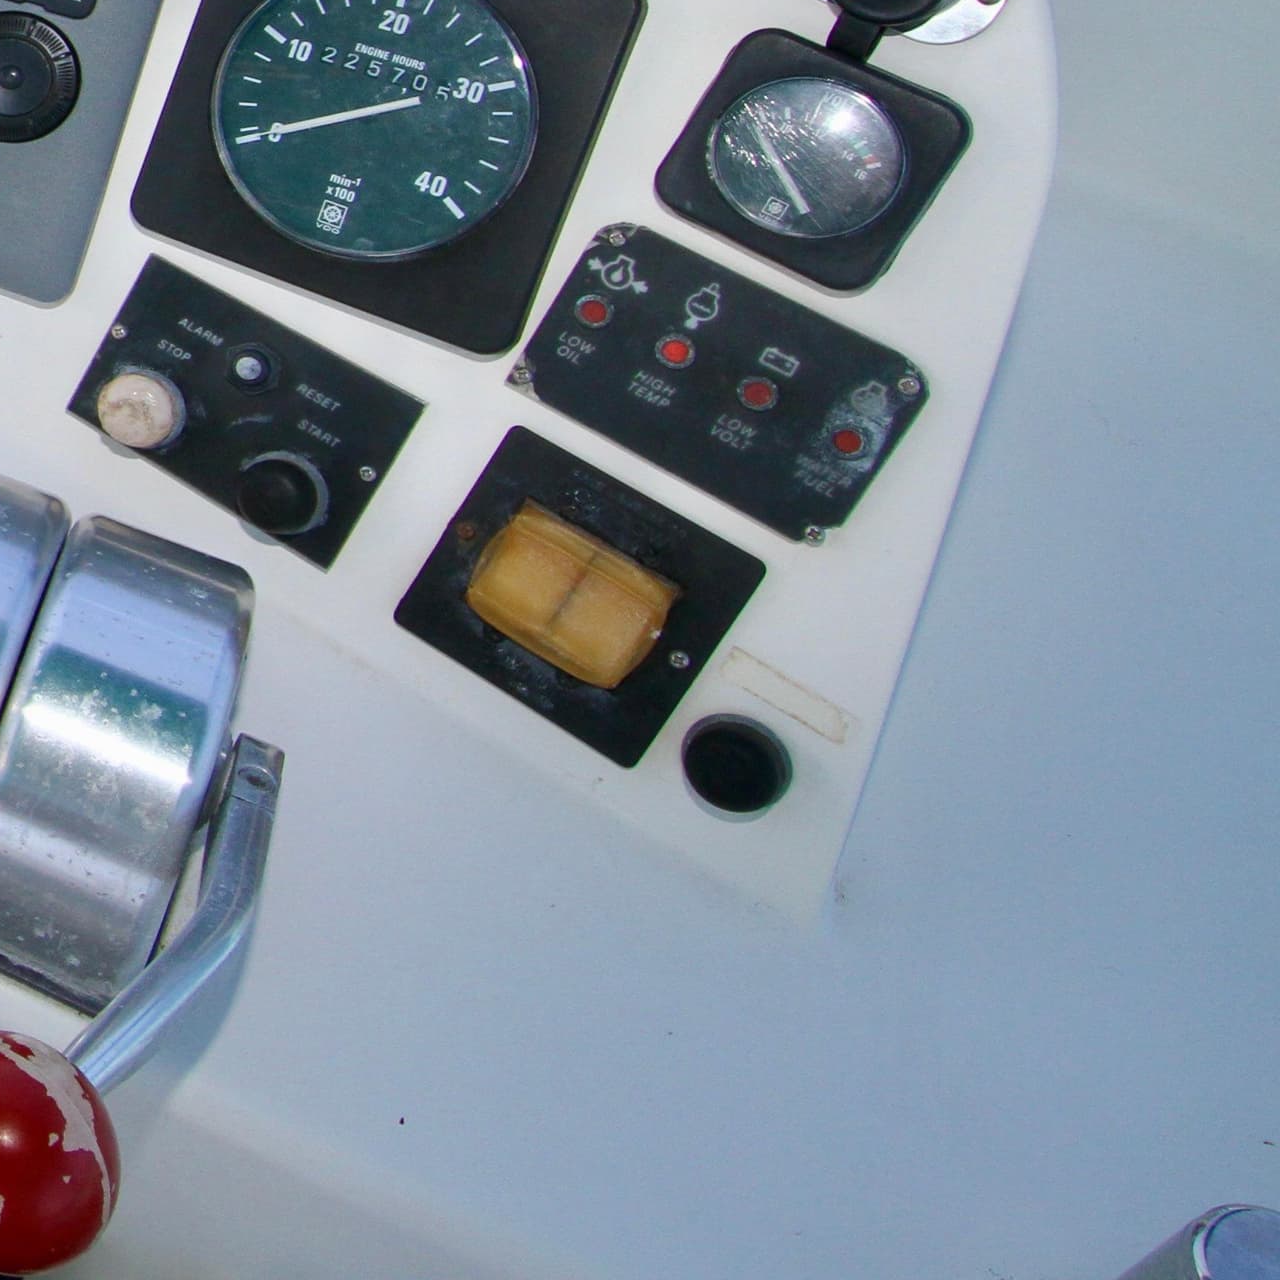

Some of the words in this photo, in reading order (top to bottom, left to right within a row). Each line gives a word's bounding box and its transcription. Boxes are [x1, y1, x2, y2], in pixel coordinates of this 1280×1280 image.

[378, 10, 411, 35] 20
[288, 37, 314, 63] 10
[354, 42, 391, 61] ENGINE
[391, 53, 427, 71] HOURS
[451, 76, 486, 105] 30
[414, 170, 449, 198] 40
[853, 167, 869, 182] 16
[324, 185, 357, 204] x100
[315, 221, 342, 235] VDO
[177, 317, 225, 348] ALARM
[559, 331, 597, 356] LOW
[157, 338, 193, 361] STOP
[555, 344, 582, 367] OIL
[295, 383, 342, 413] RESET
[626, 380, 672, 409] TEMP
[634, 371, 678, 398] HIGH
[296, 419, 342, 448] START
[709, 424, 755, 451] VOLT
[716, 413, 760, 440] LOW
[794, 470, 834, 499] FUEL
